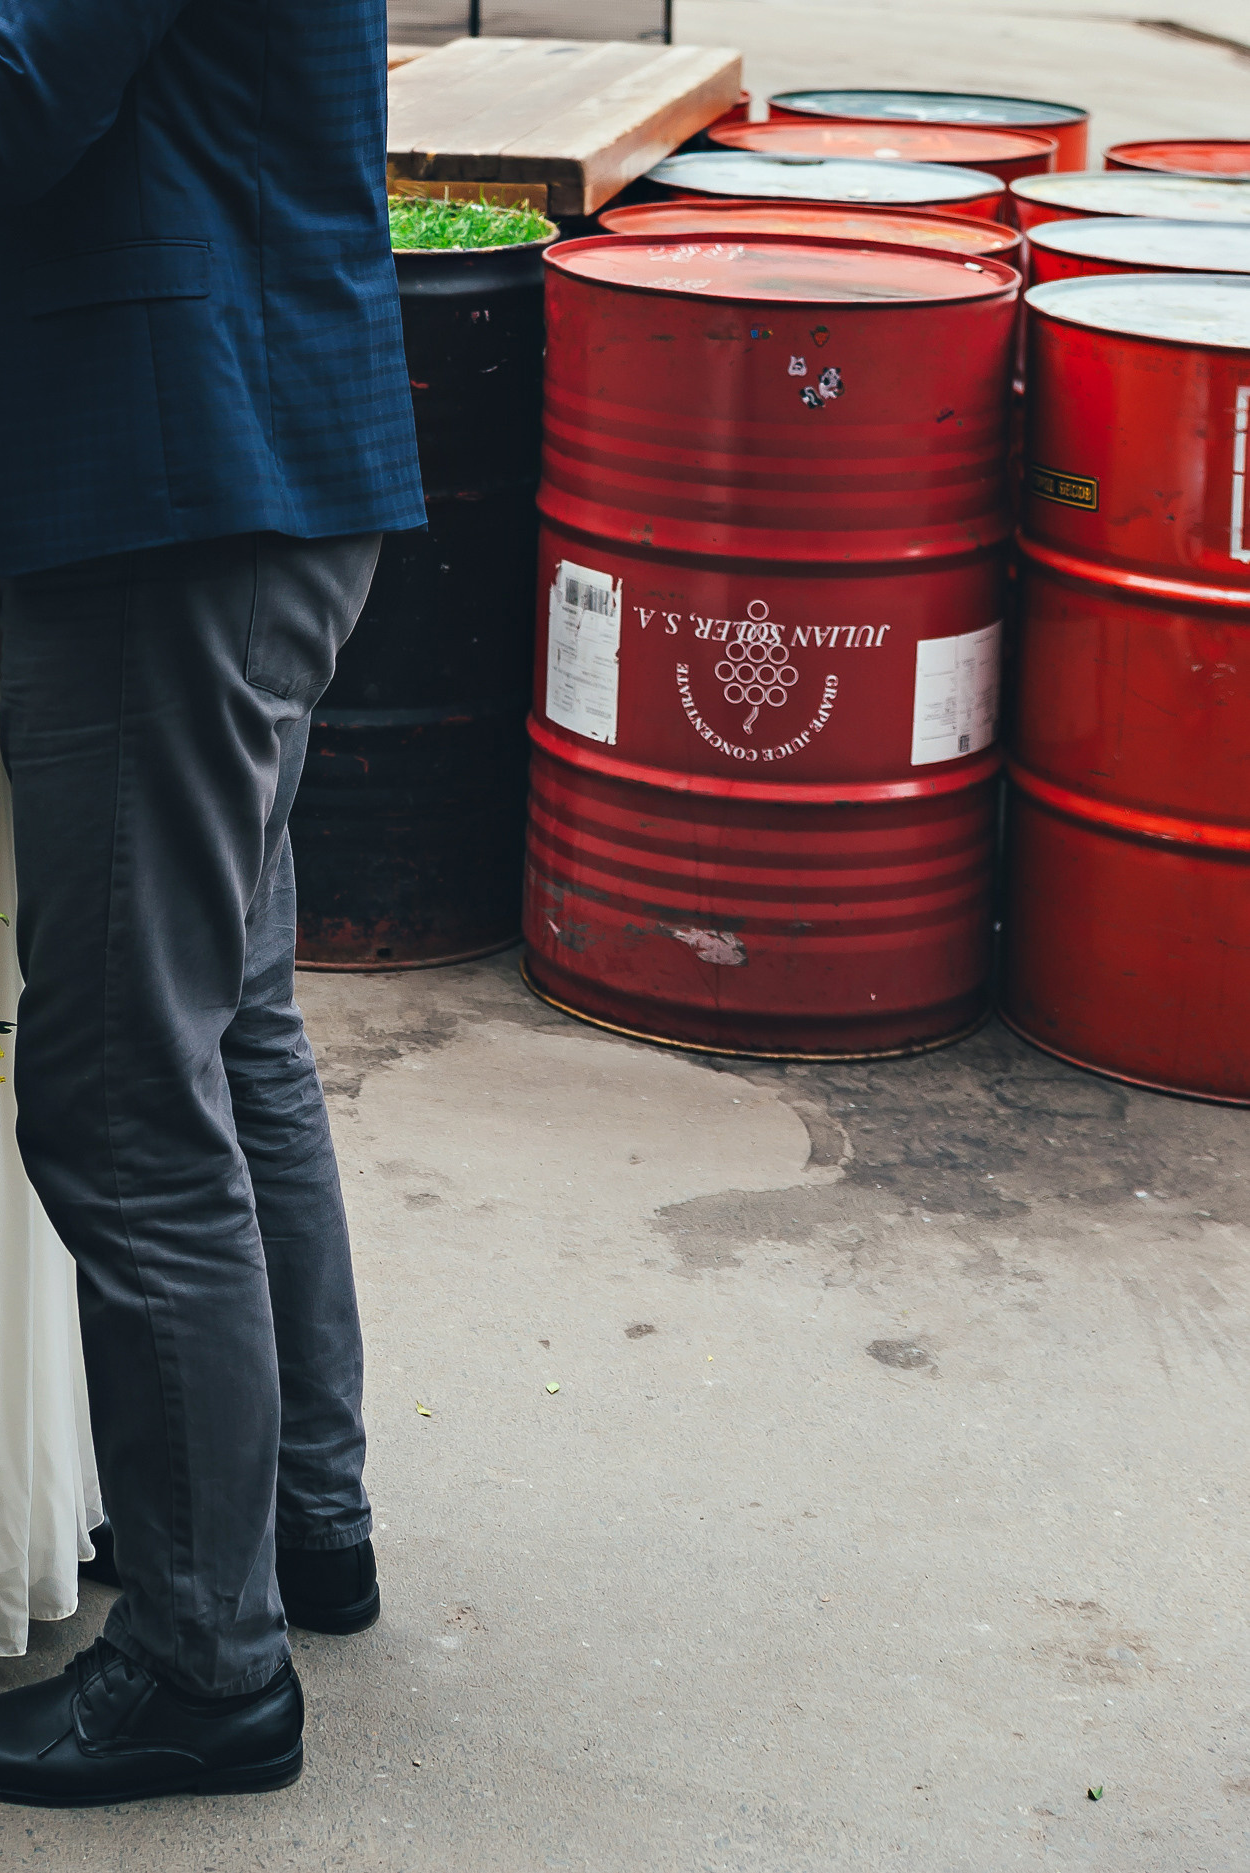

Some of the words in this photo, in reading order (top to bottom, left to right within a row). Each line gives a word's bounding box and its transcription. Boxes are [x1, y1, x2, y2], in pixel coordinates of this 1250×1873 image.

[633, 606, 656, 630] A.
[661, 612, 682, 636] S.
[689, 611, 786, 646] SOLER,
[791, 623, 891, 648] JULIAN
[676, 662, 758, 762] CONCENTRATE
[808, 674, 839, 733] GRAPE
[761, 729, 812, 762] JUICE
